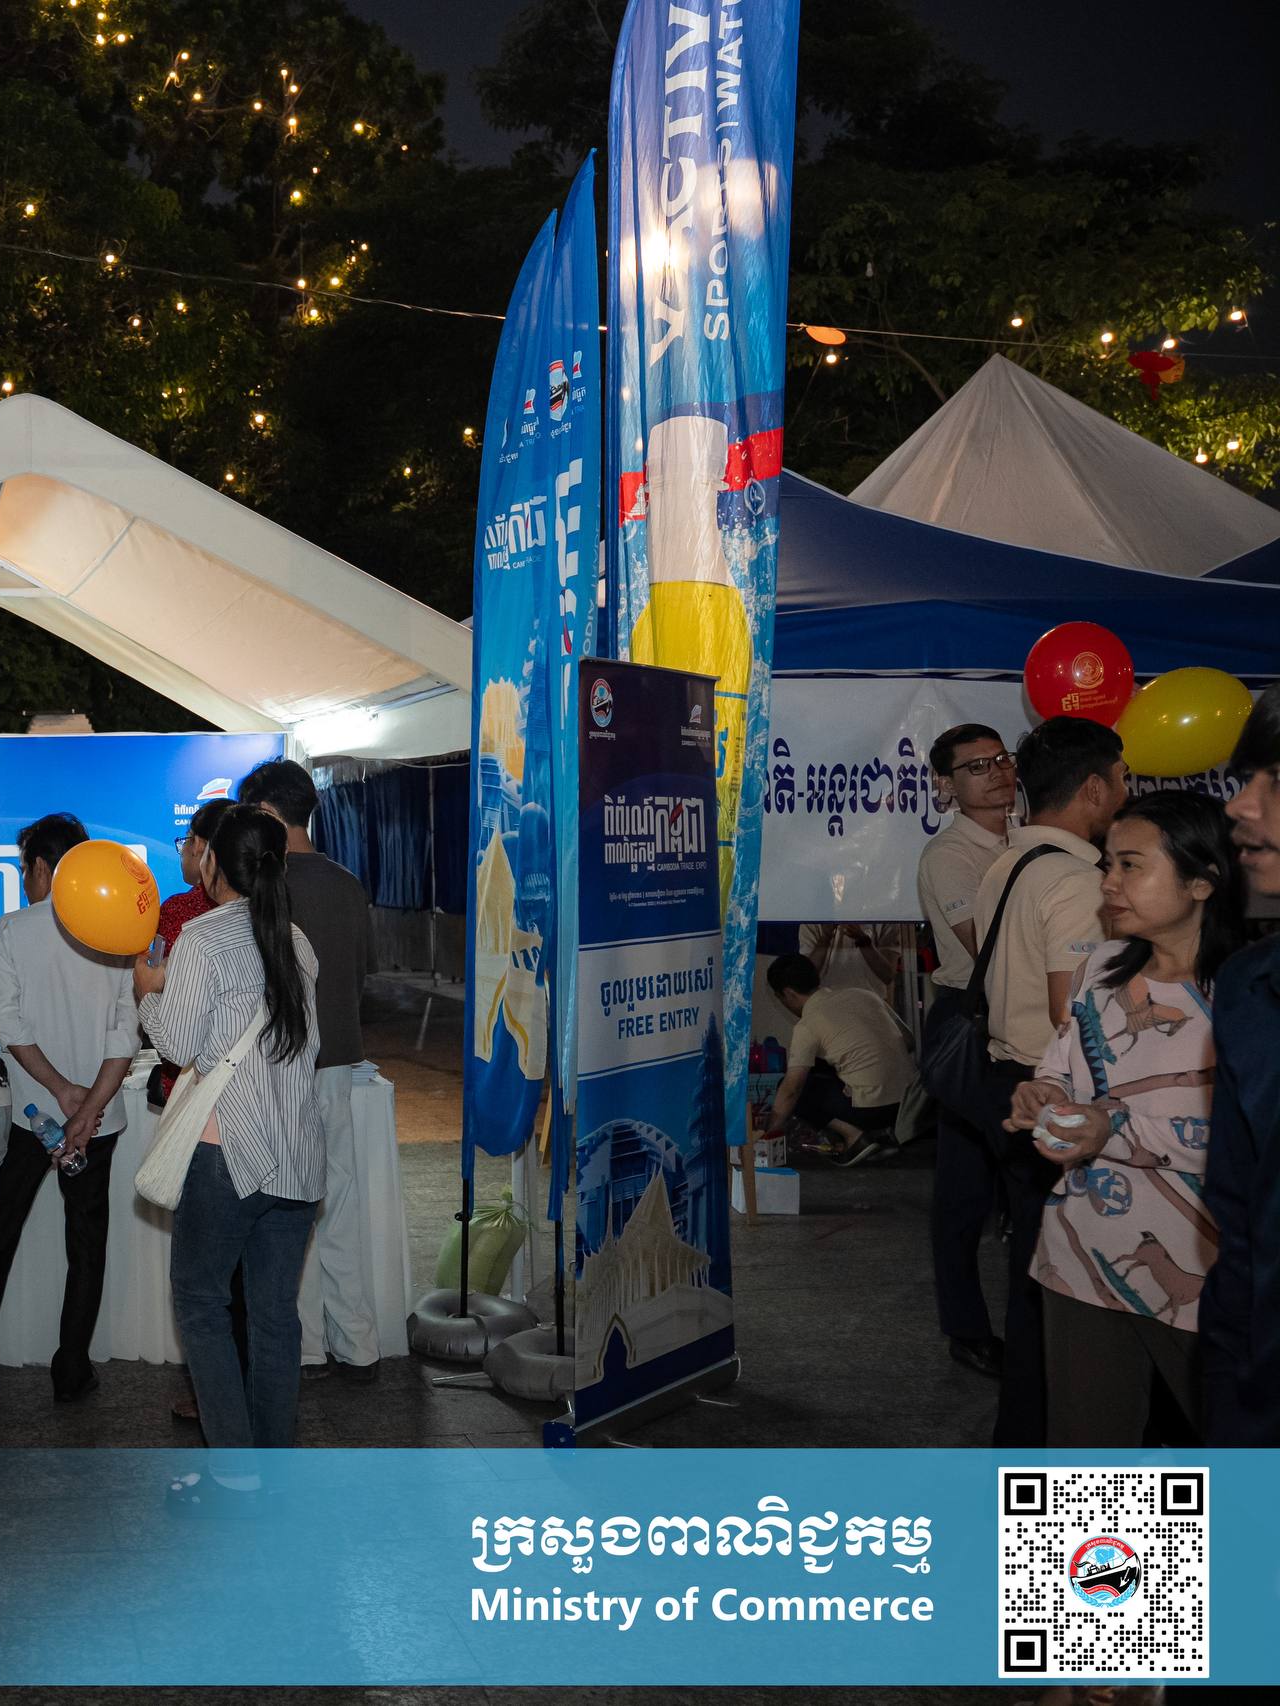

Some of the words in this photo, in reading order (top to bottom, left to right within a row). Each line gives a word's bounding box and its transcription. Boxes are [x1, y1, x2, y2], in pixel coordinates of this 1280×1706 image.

[716, 0, 743, 114] WAT
[656, 862, 680, 871] CAMBODIA
[680, 861, 695, 870] TRADE
[696, 860, 707, 869] EXPO
[600, 956, 714, 1017] ចូលរួមដោយសេរី
[618, 1014, 655, 1039] FREE
[659, 1006, 700, 1032] ENTRY
